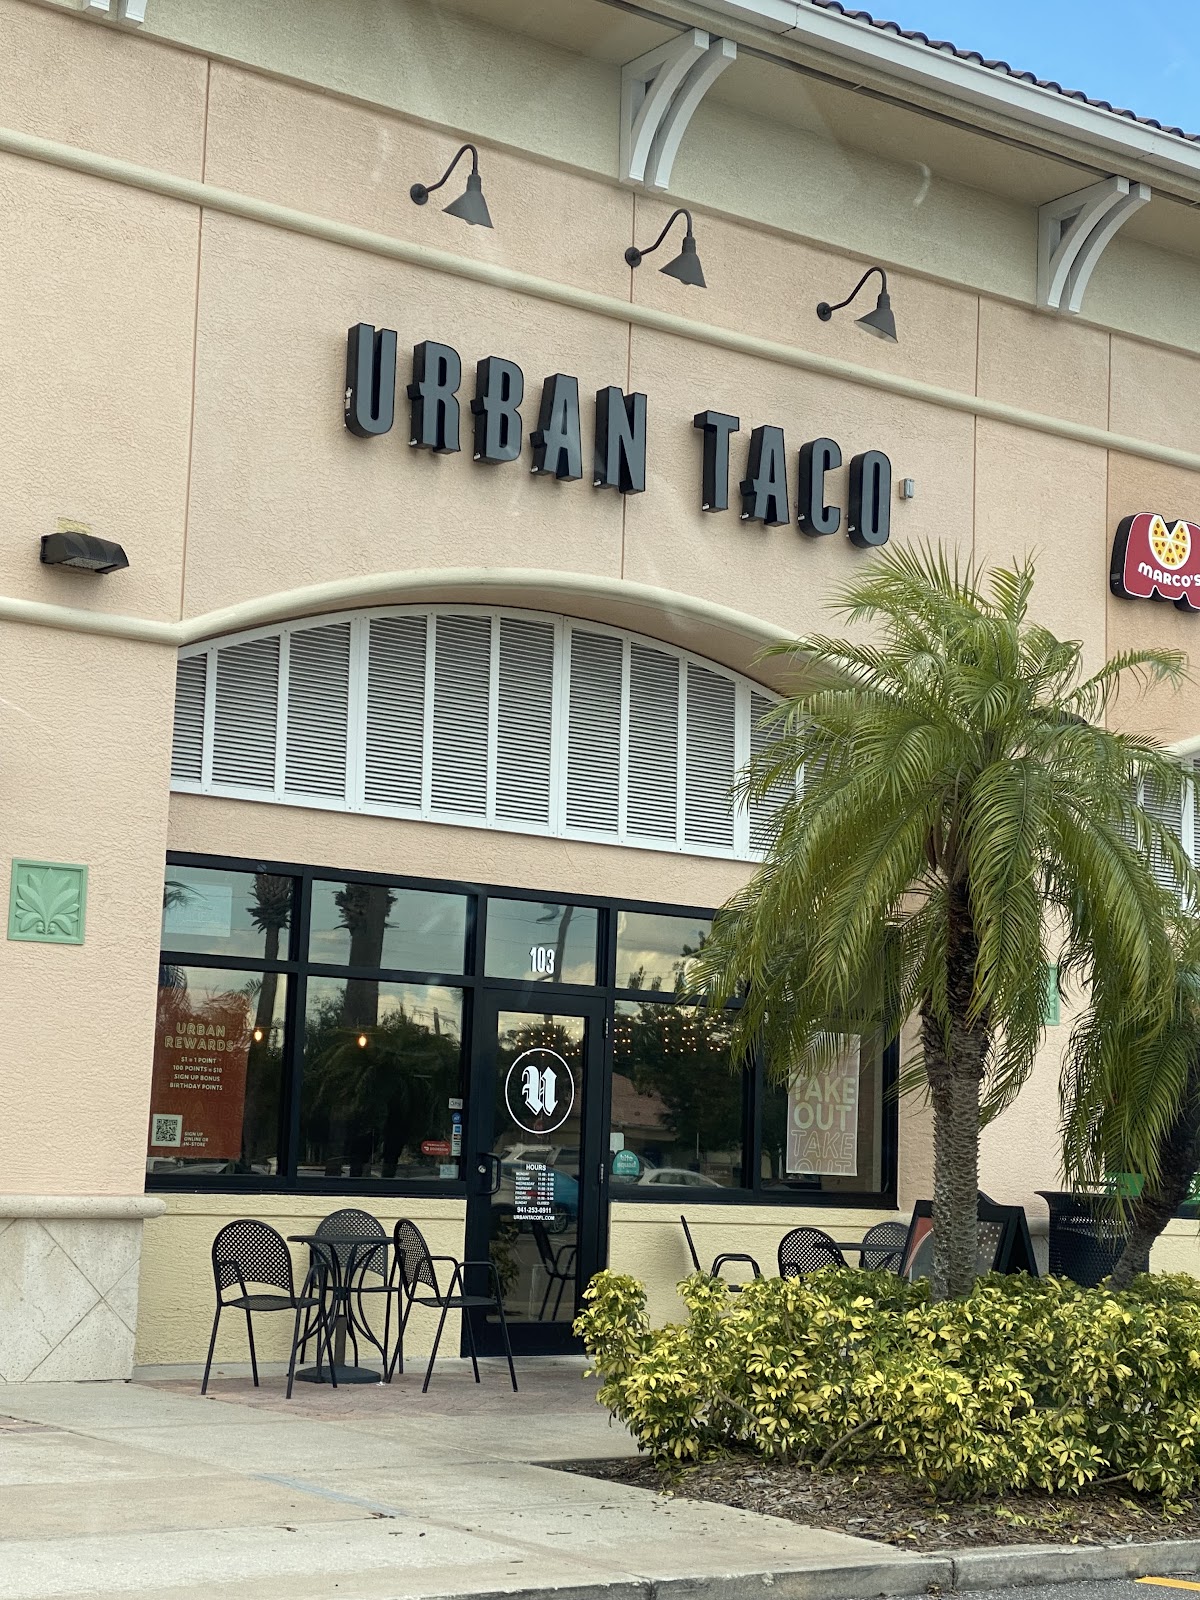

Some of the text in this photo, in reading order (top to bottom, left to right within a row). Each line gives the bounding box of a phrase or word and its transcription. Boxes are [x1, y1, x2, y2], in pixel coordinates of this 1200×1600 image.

[344, 322, 892, 549] URBAN TACO
[1138, 562, 1200, 587] MARCO'S
[530, 947, 555, 974] 103
[176, 1022, 225, 1037] URBAN
[165, 1036, 234, 1052] REWARDS
[790, 1073, 856, 1104] TAKE
[794, 1102, 852, 1132] OUT
[791, 1130, 855, 1160] TAKE
